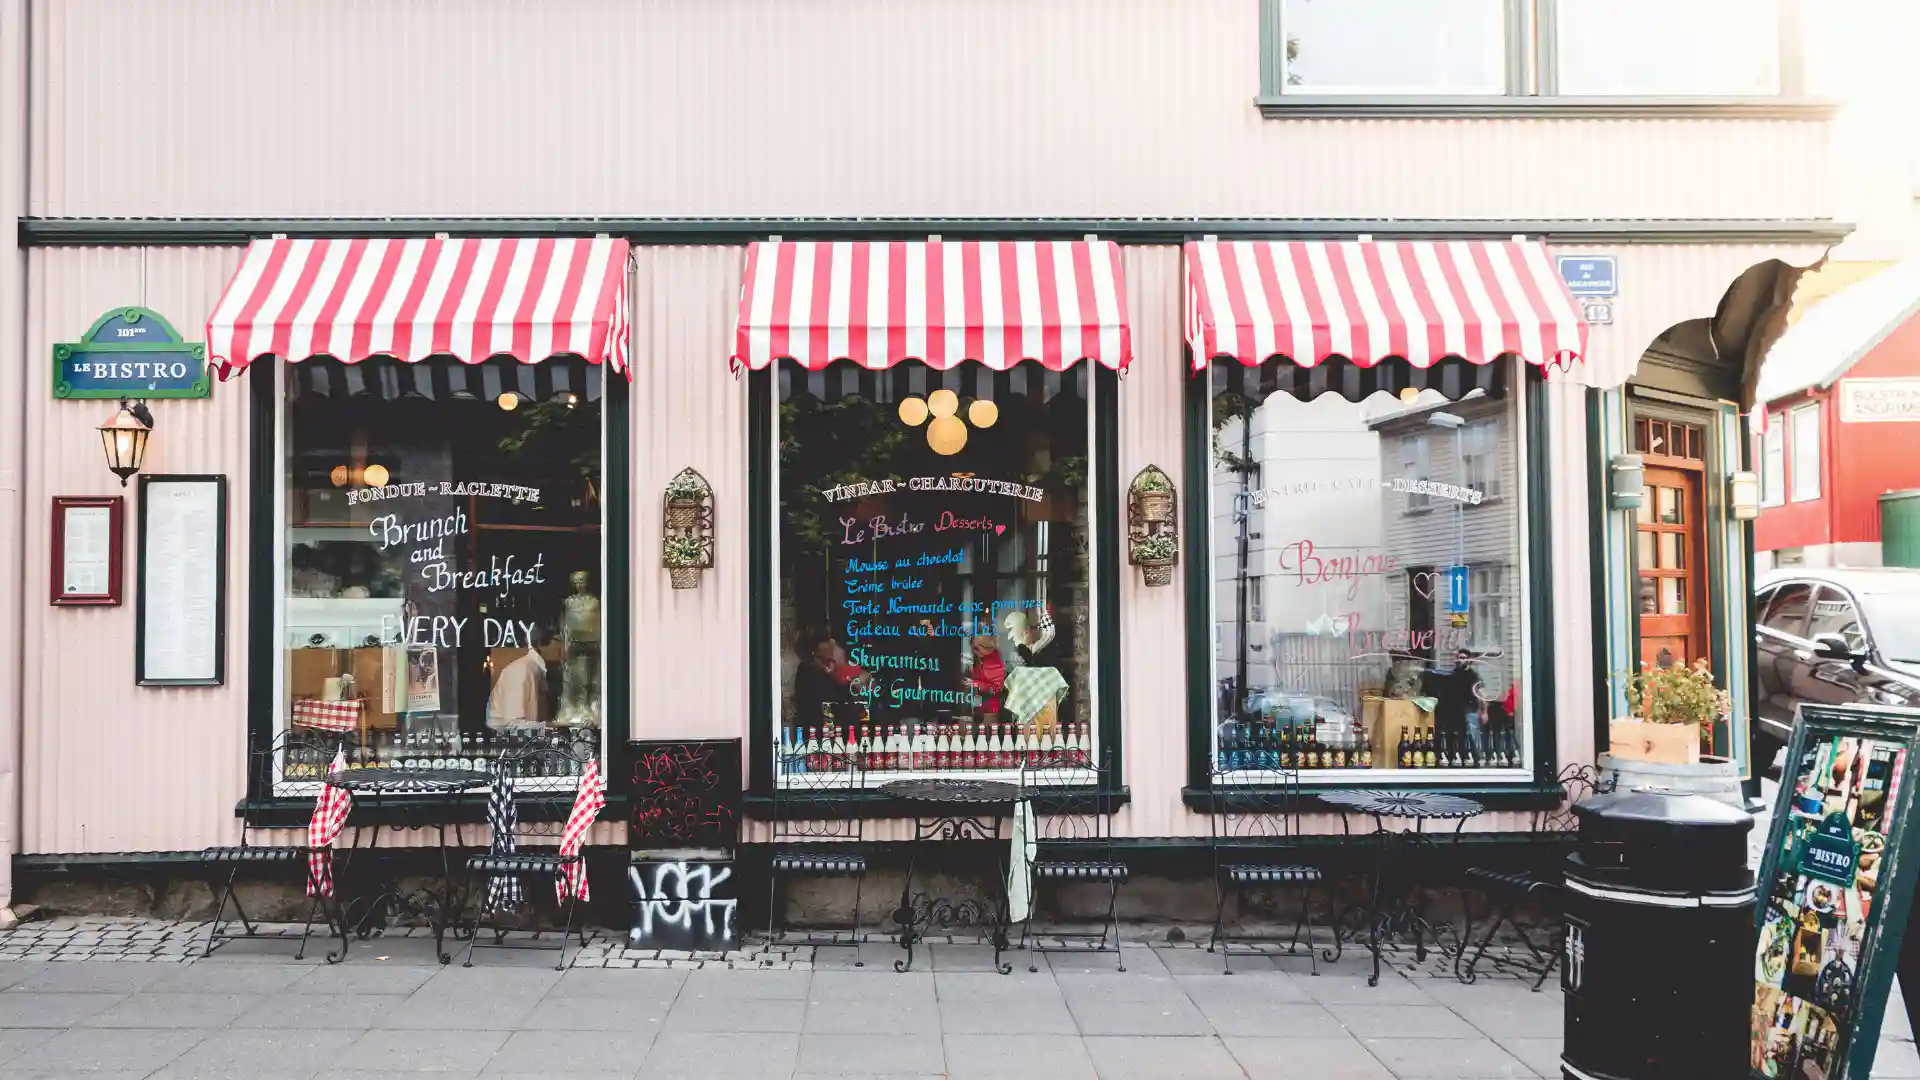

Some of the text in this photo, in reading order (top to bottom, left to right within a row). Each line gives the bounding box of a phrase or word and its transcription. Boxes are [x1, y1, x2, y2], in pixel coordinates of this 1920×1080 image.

[1587, 305, 1608, 320] 12
[73, 362, 187, 379] LE BISTRO
[369, 505, 469, 551] Brunch
[838, 514, 866, 546] Le
[933, 510, 993, 532] Desserts
[410, 537, 445, 563] and
[845, 547, 968, 574] Mousse au chocolat
[421, 552, 546, 598] Breakfast
[380, 614, 535, 649] EVERY DAY
[889, 678, 978, 709] Gourmand
[1814, 848, 1851, 868] BISTRO
